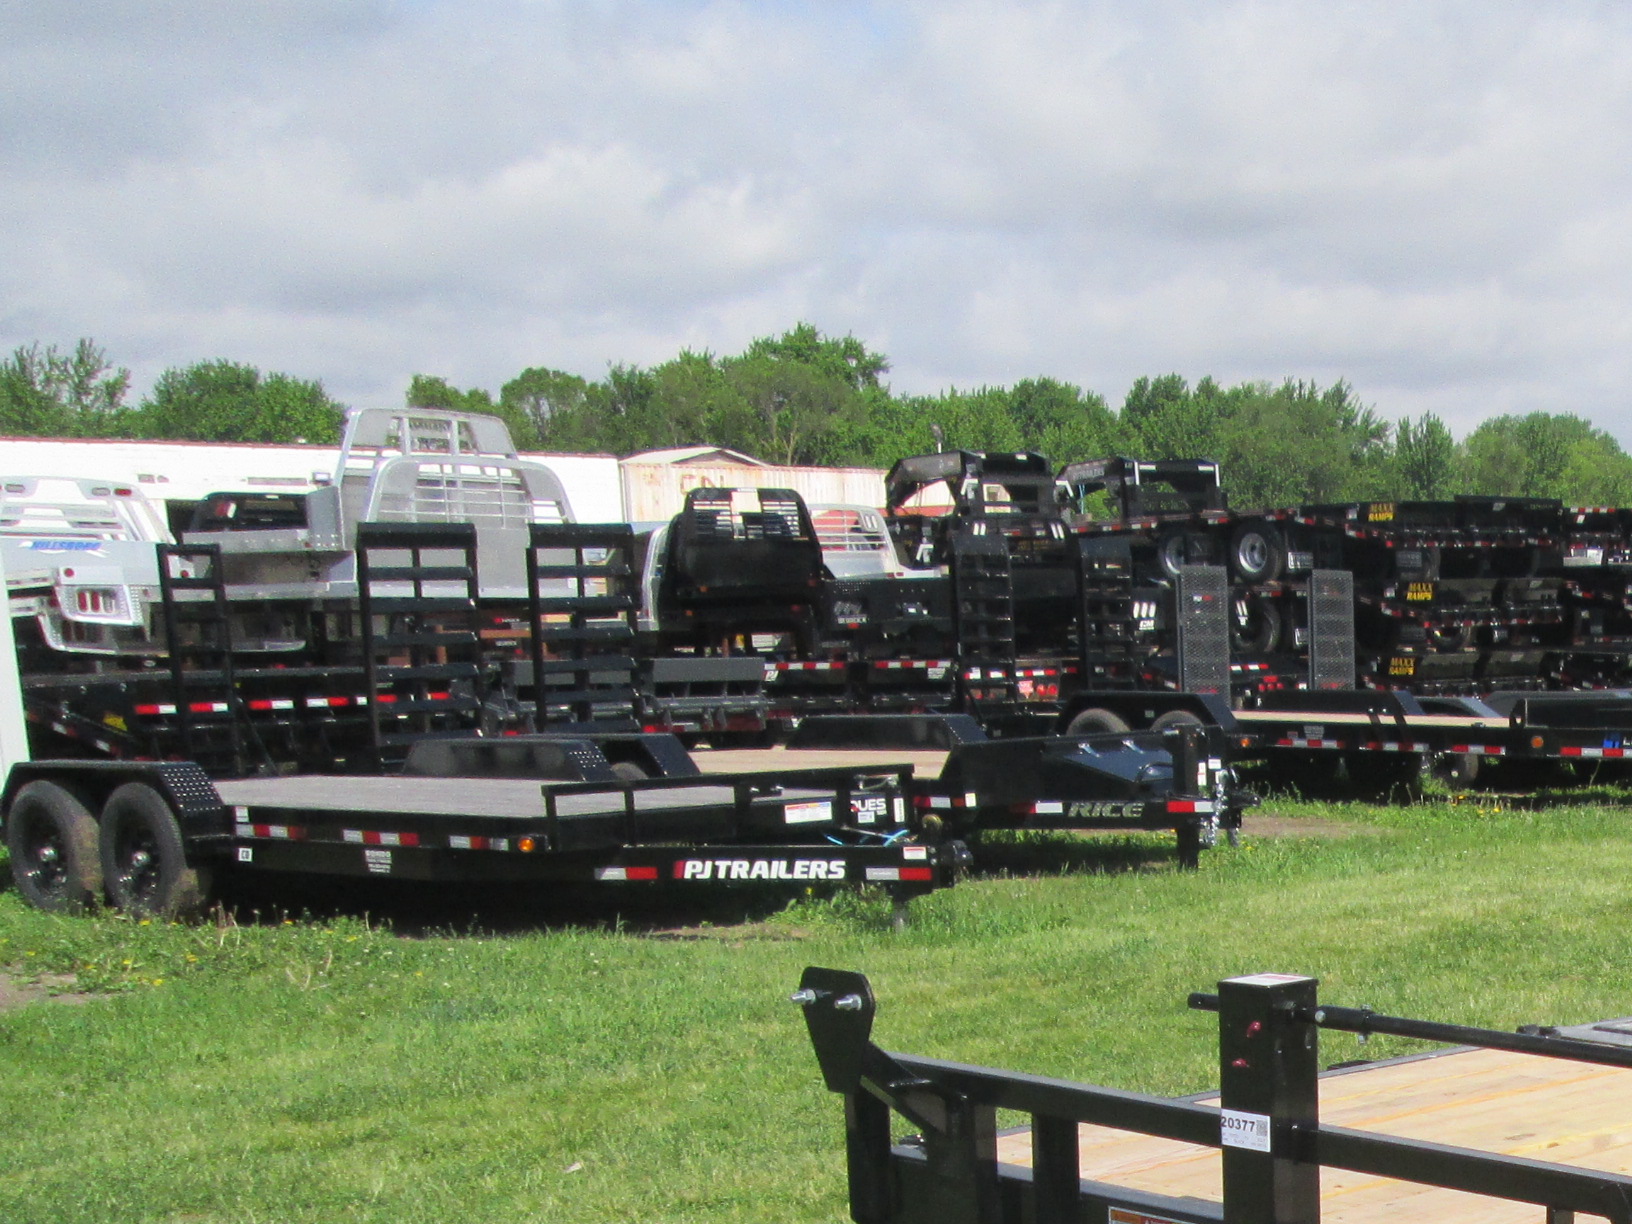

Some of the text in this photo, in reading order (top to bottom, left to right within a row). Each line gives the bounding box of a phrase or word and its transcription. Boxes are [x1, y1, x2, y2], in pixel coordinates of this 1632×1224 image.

[1368, 511, 1394, 521] RAMPS
[1406, 590, 1432, 601] RAMPS
[1388, 665, 1414, 675] RAMPS
[1068, 801, 1144, 817] RICE
[684, 860, 847, 879] PJ TRAILERS
